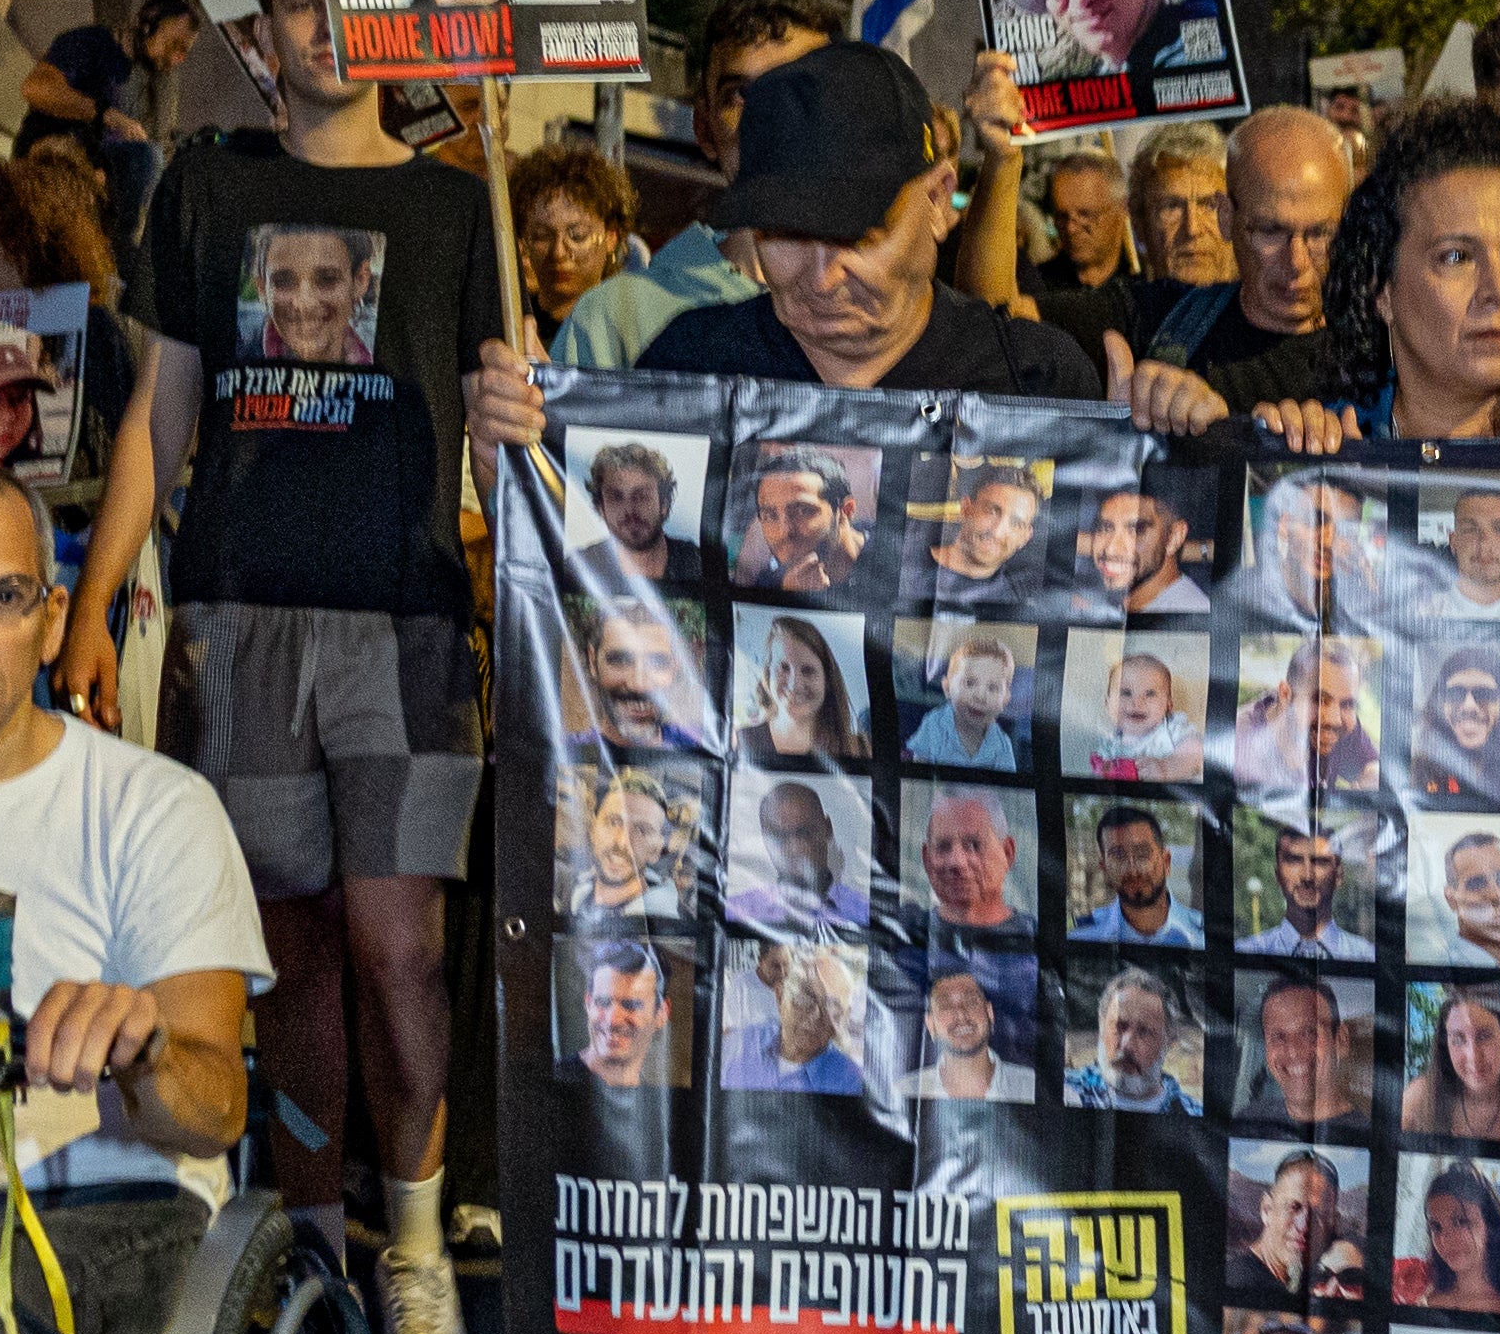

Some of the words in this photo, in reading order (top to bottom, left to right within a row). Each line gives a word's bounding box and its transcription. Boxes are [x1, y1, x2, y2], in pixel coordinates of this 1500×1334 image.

[341, 14, 424, 60] HOME
[429, 4, 514, 59] NOW!
[994, 14, 1057, 53] BRING
[1013, 51, 1040, 86] IM
[1020, 82, 1069, 119] OME
[1067, 71, 1133, 114] NOW!
[555, 1173, 688, 1241] להחזרת
[696, 1182, 882, 1244] המשפחות
[893, 1190, 970, 1251] מטה
[555, 1237, 755, 1323] והנעדרים
[1023, 1215, 1157, 1303] שנה
[769, 1248, 967, 1333] החטופים
